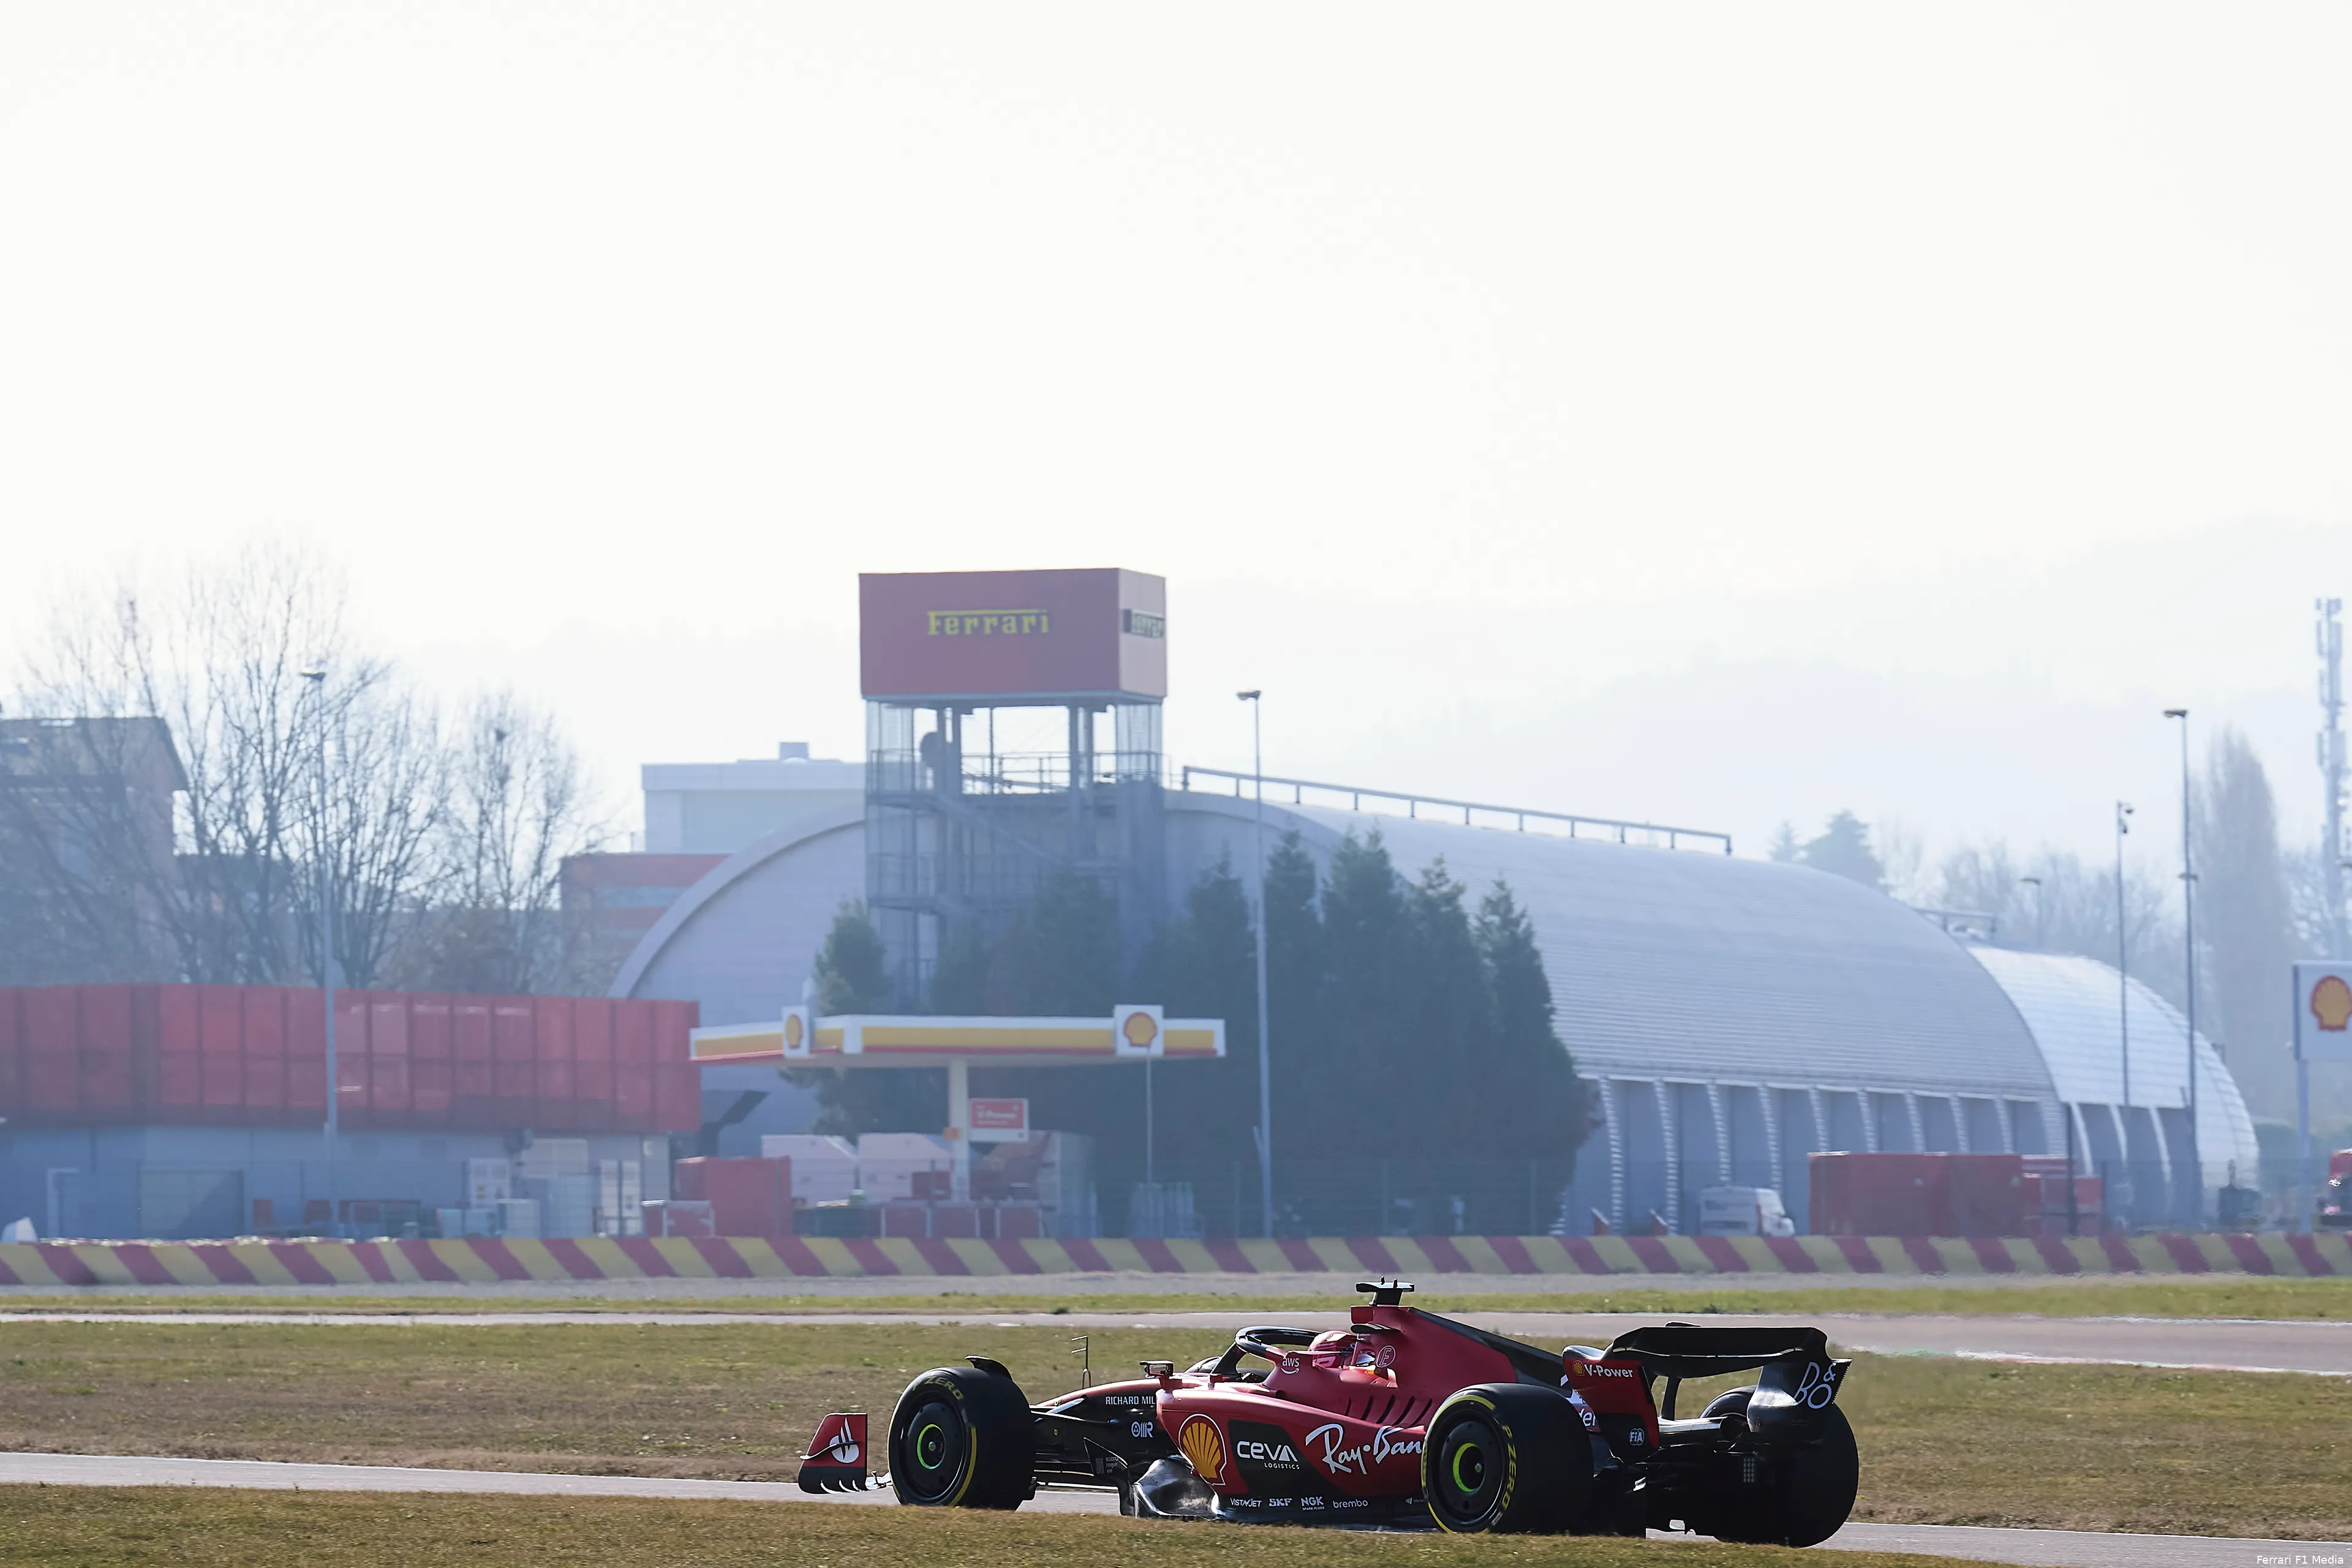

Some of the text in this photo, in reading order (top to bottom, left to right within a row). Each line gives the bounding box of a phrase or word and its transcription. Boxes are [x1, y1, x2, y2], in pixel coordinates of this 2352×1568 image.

[927, 609, 1049, 635] Ferrari
[1283, 1357, 1300, 1367] aws
[1585, 1364, 1634, 1378] V-Power
[924, 1376, 964, 1401] ZERO
[1106, 1396, 1156, 1405] RICHARD MIL
[1630, 1431, 1643, 1442] FIA
[1502, 1443, 1517, 1510] ZERO
[1269, 1498, 1292, 1507] SKF
[1300, 1496, 1324, 1506] NGK
[1333, 1499, 1368, 1509] brembo
